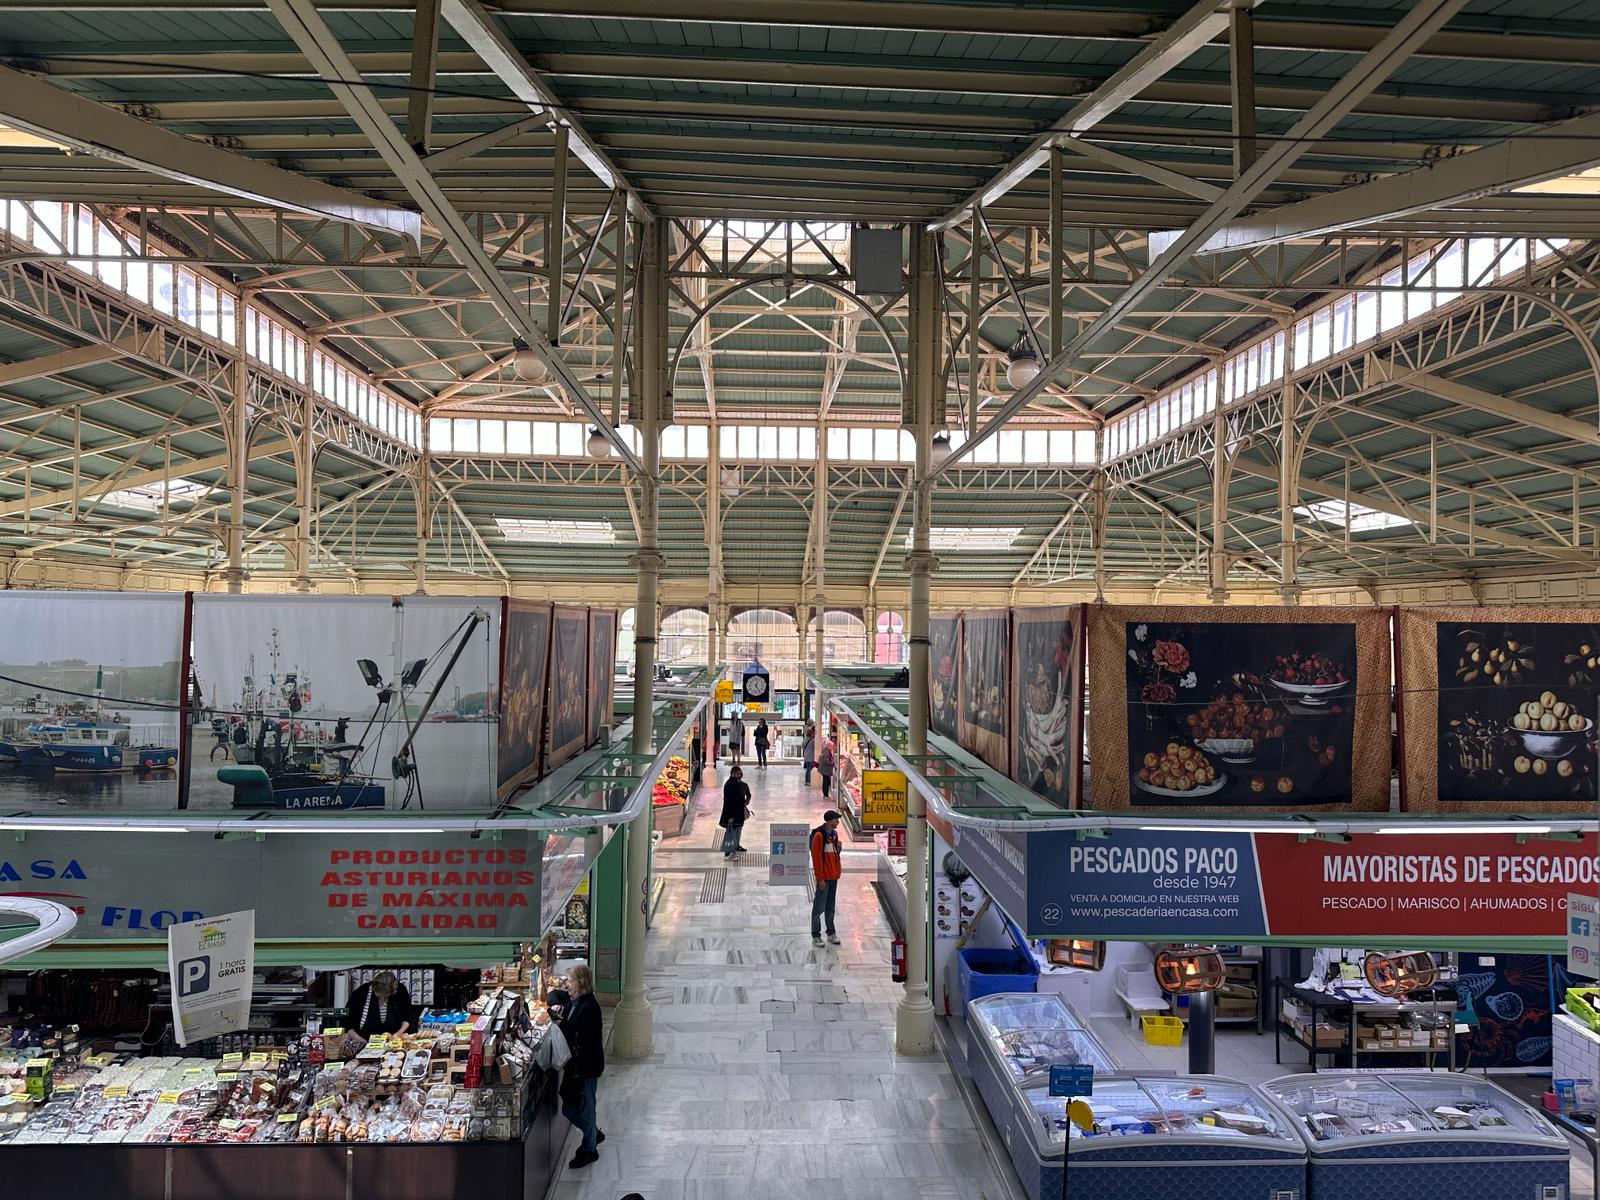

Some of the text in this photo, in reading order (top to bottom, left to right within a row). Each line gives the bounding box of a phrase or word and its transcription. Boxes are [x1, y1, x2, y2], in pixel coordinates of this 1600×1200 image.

[286, 798, 301, 808] LA
[864, 799, 876, 813] EL
[330, 849, 528, 865] PRODUCTOS
[1070, 847, 1238, 874] PESCADOS PACO
[1323, 855, 1457, 883] MAYORISTAS
[1464, 856, 1490, 883] DE
[320, 870, 535, 886] ASTURIANOS
[1153, 875, 1236, 889] desde 1947
[328, 889, 528, 908] DE MÁXIMA
[1070, 894, 1239, 903] VENTA A DOMICILIO EN NUESTRA WEB
[1322, 897, 1387, 909] PESCADO
[1398, 897, 1460, 909] MARISCO
[1470, 897, 1547, 909] AHUMADOS
[1044, 908, 1059, 920] 22
[1071, 907, 1238, 918] www.pescaderiaencasa.com
[357, 914, 498, 929] CALIDAD
[226, 959, 245, 968] hora
[183, 960, 206, 994] P
[218, 966, 246, 977] GRATIS
